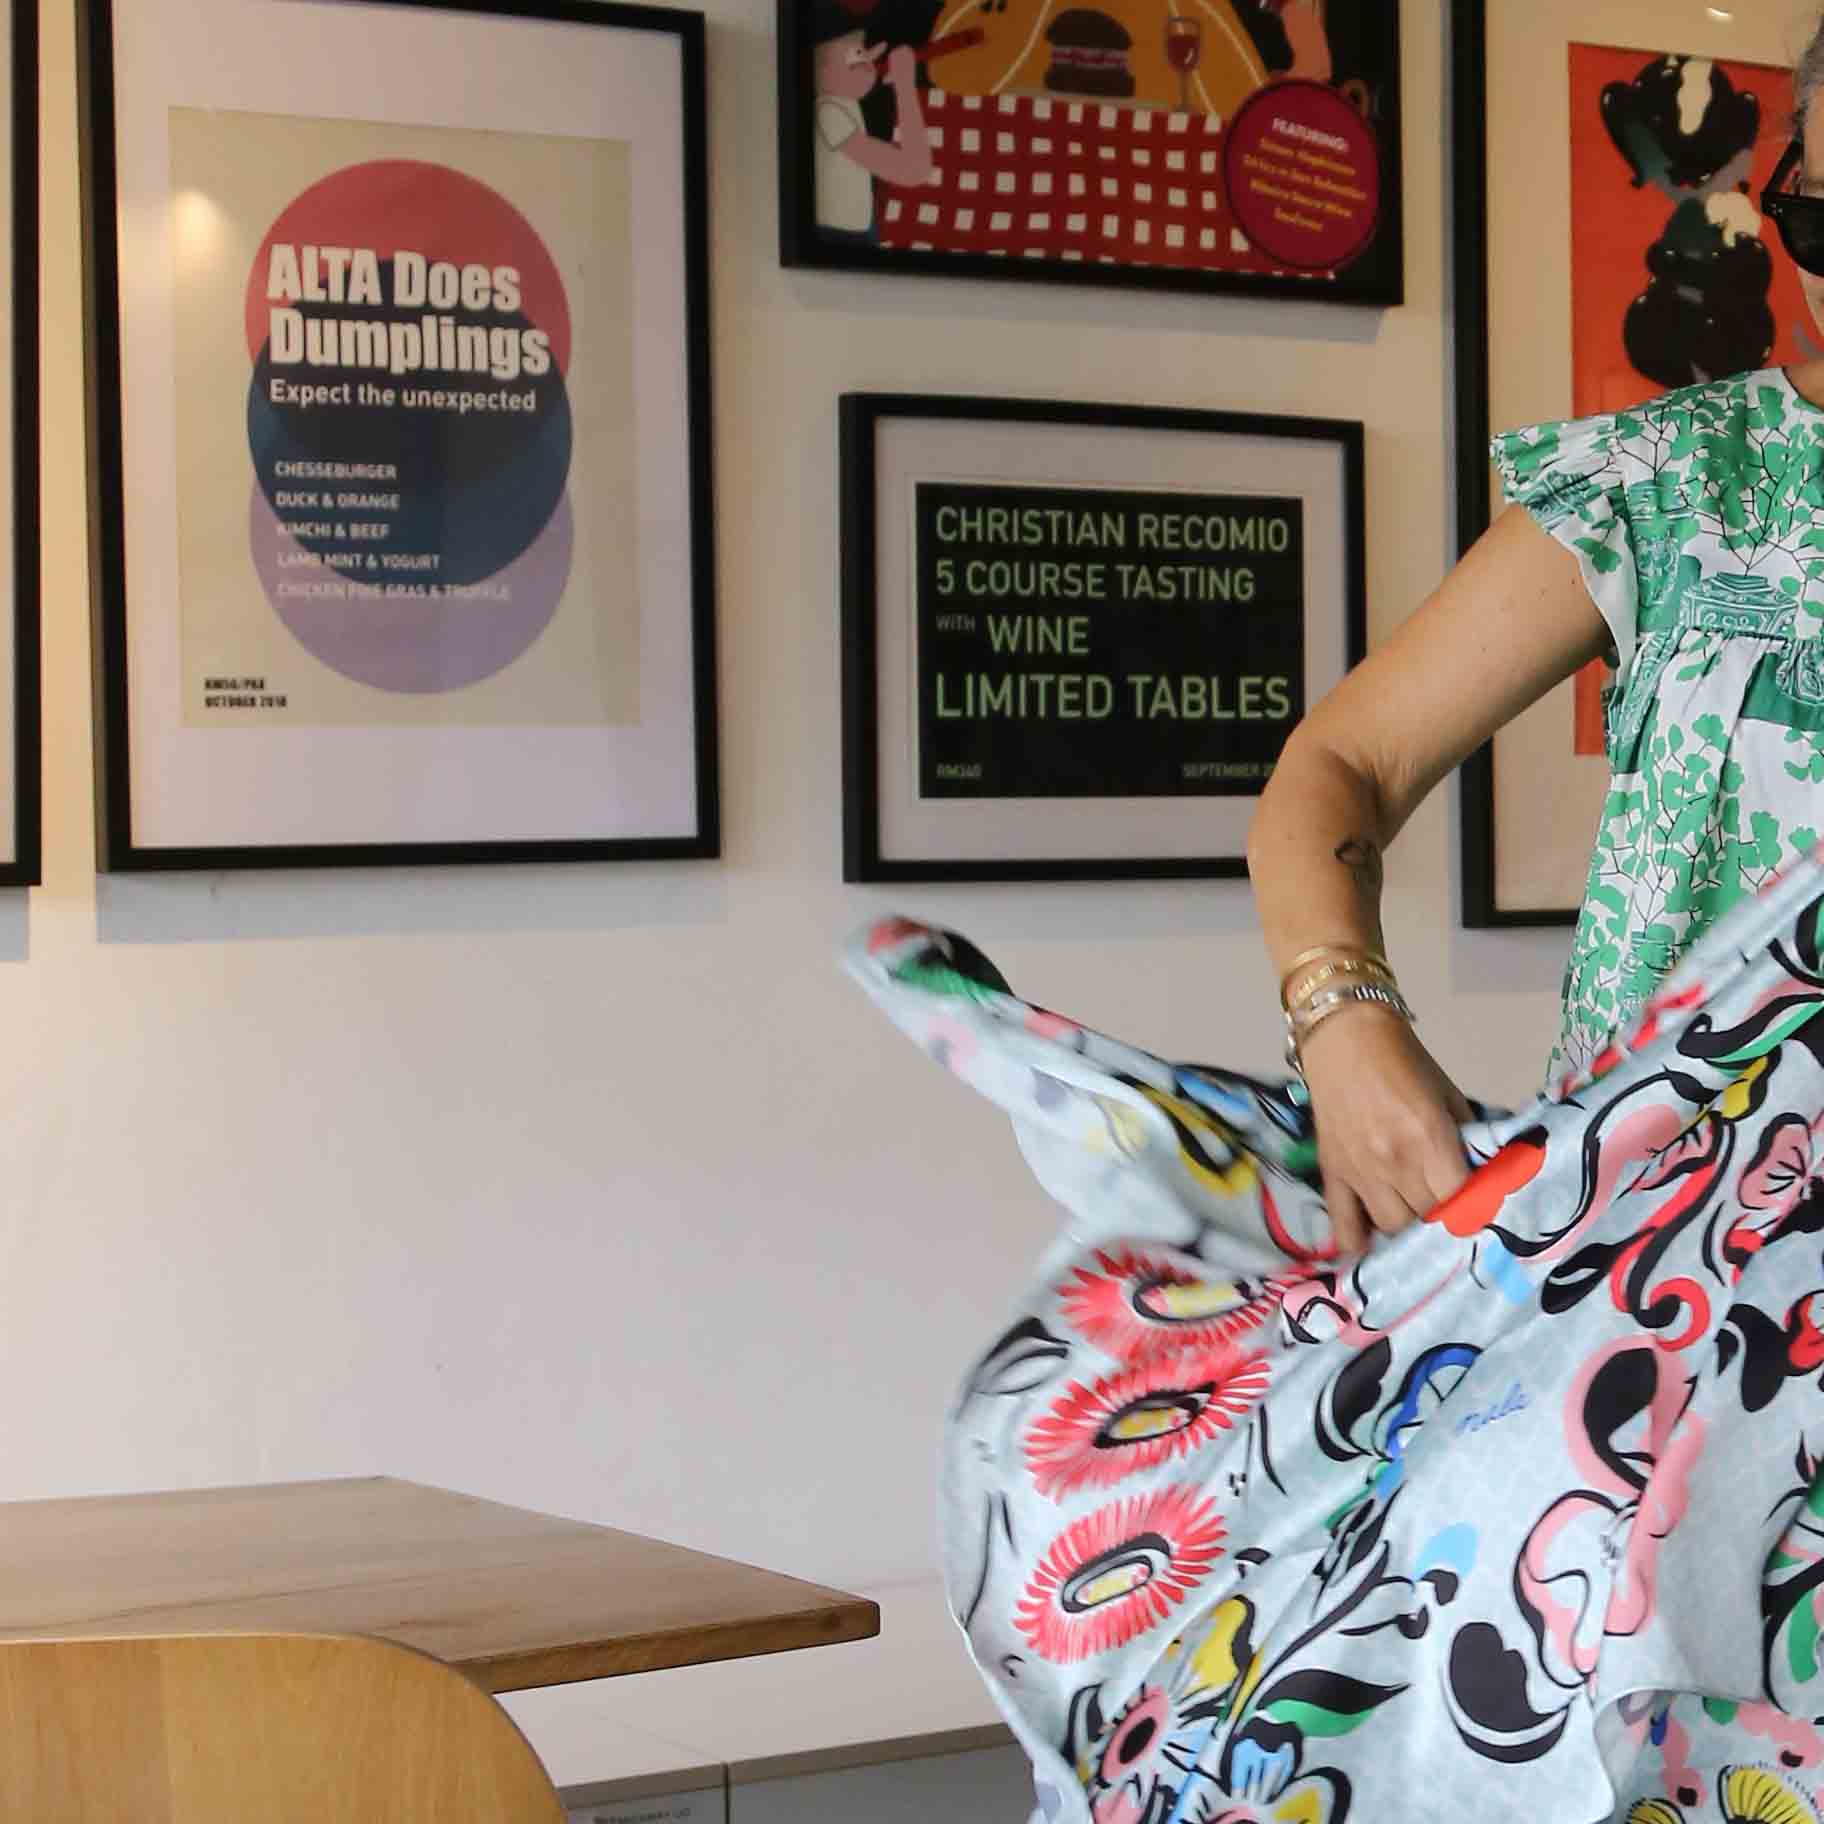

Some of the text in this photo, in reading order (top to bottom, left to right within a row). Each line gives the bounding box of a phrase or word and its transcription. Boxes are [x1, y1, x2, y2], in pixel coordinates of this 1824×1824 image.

[266, 243, 521, 313] ALTA Does
[268, 307, 551, 380] Dumplings
[269, 379, 537, 415] Expect the unexpected
[275, 491, 399, 510] DUCK & ORANGE
[277, 523, 390, 539] KIMCHI & BEEF
[935, 505, 1289, 554] CHRISTIAN RECOMIO
[323, 553, 362, 569] MINT
[366, 554, 377, 569] &
[382, 553, 440, 569] YOGURT
[935, 559, 1256, 602] 5 COURSE TASTING
[936, 613, 1090, 655] WITH WINE
[935, 672, 1291, 721] LIMITED TABLES
